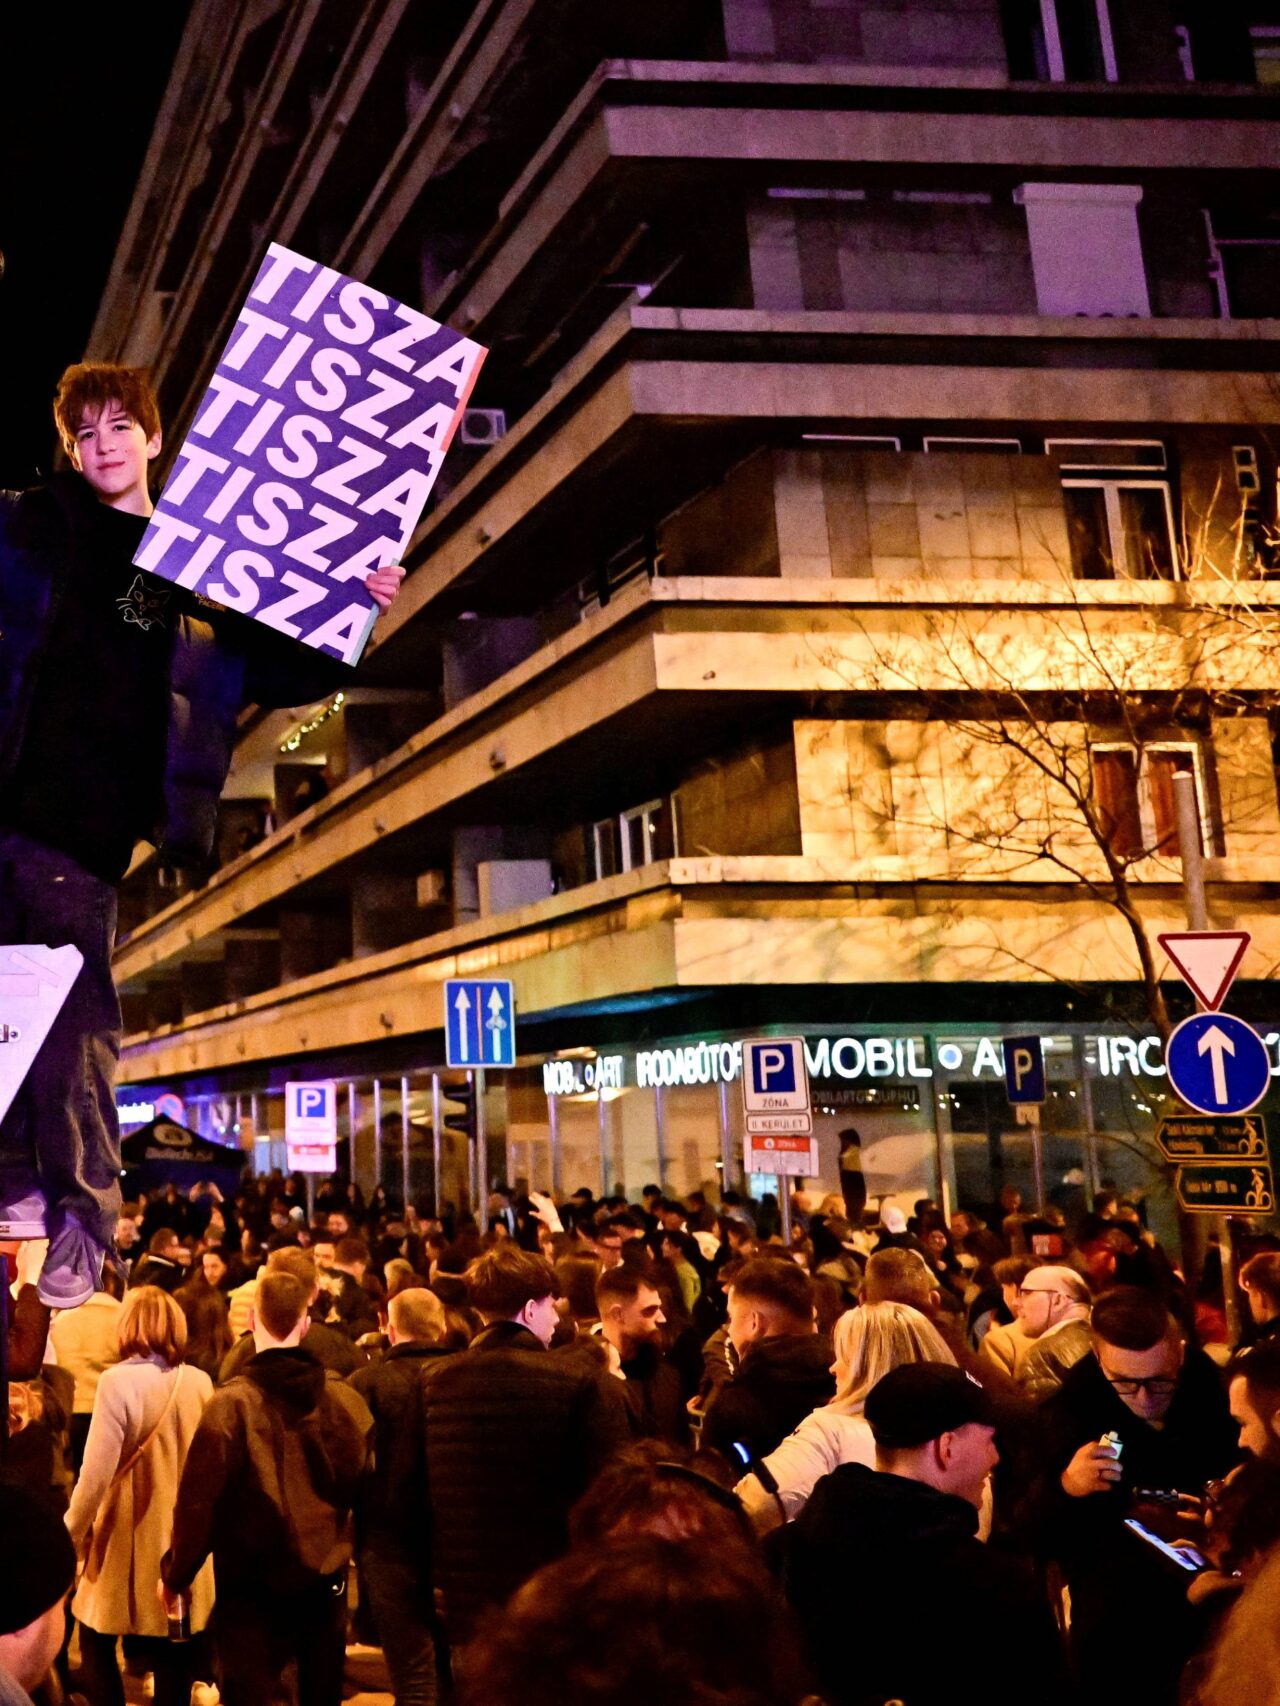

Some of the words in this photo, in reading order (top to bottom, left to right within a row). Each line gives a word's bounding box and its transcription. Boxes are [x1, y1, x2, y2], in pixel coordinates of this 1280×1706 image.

[250, 242, 482, 399] TISZA
[222, 308, 456, 464] TISZA
[193, 375, 428, 532] TISZA
[163, 442, 402, 588] TISZA
[134, 511, 374, 664] TISZA
[594, 1055, 624, 1092] ART
[760, 1049, 785, 1090] P
[803, 1038, 933, 1079] MOBIL
[1014, 1048, 1032, 1091] P
[301, 1089, 322, 1116] P
[762, 1097, 789, 1108] ZÓNA
